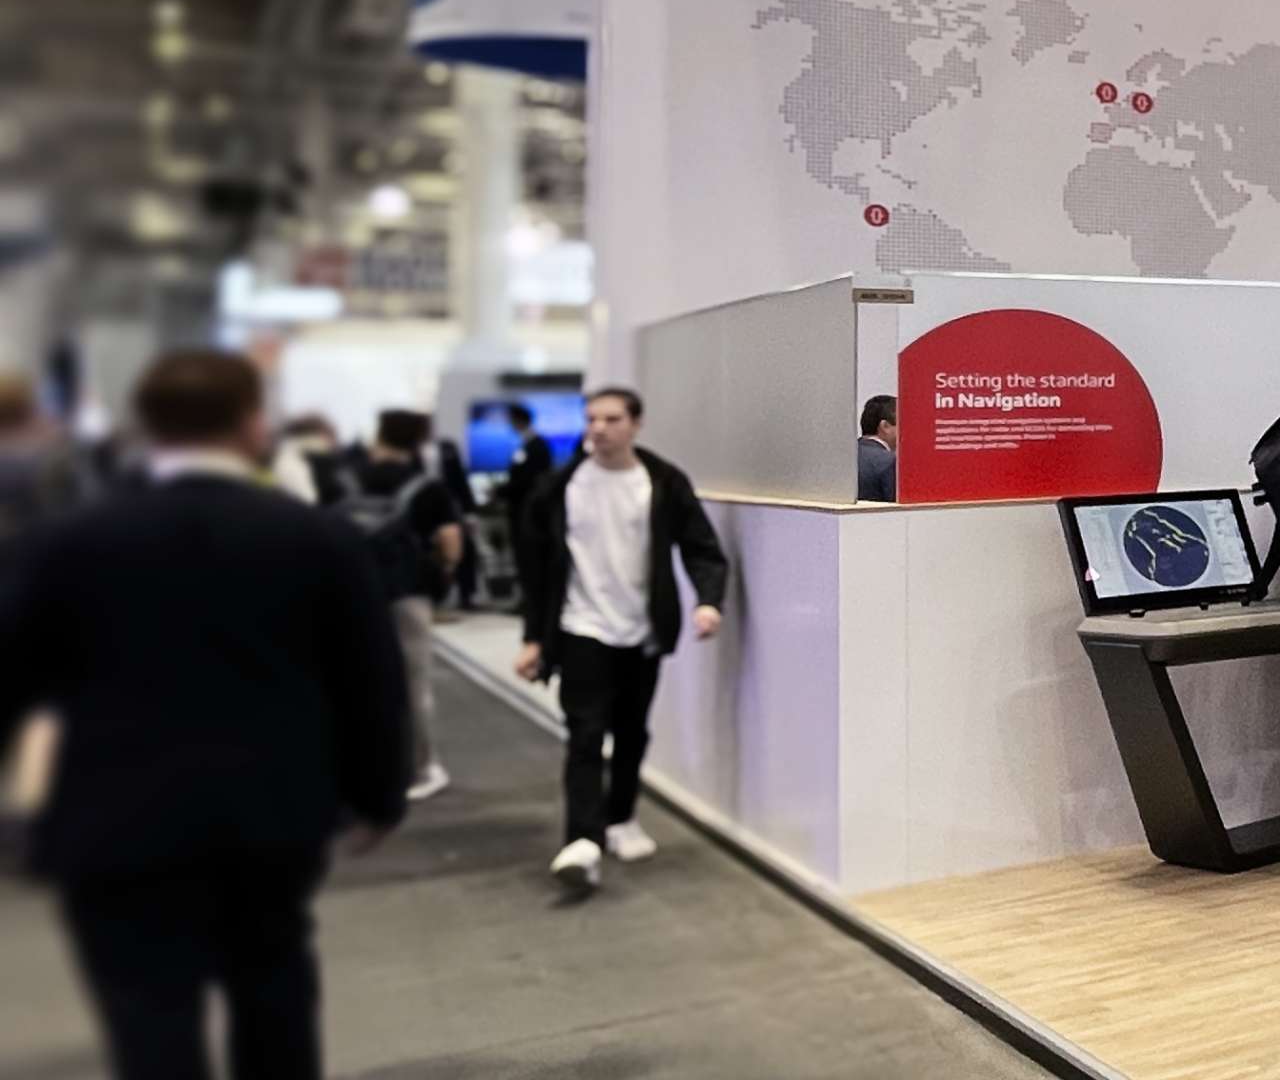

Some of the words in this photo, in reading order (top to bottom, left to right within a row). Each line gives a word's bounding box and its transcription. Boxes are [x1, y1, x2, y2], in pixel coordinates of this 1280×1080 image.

[935, 372, 1003, 391] Setting
[1006, 372, 1036, 388] the
[1039, 372, 1116, 389] standard
[935, 392, 954, 408] in
[958, 392, 1061, 411] Navigation
